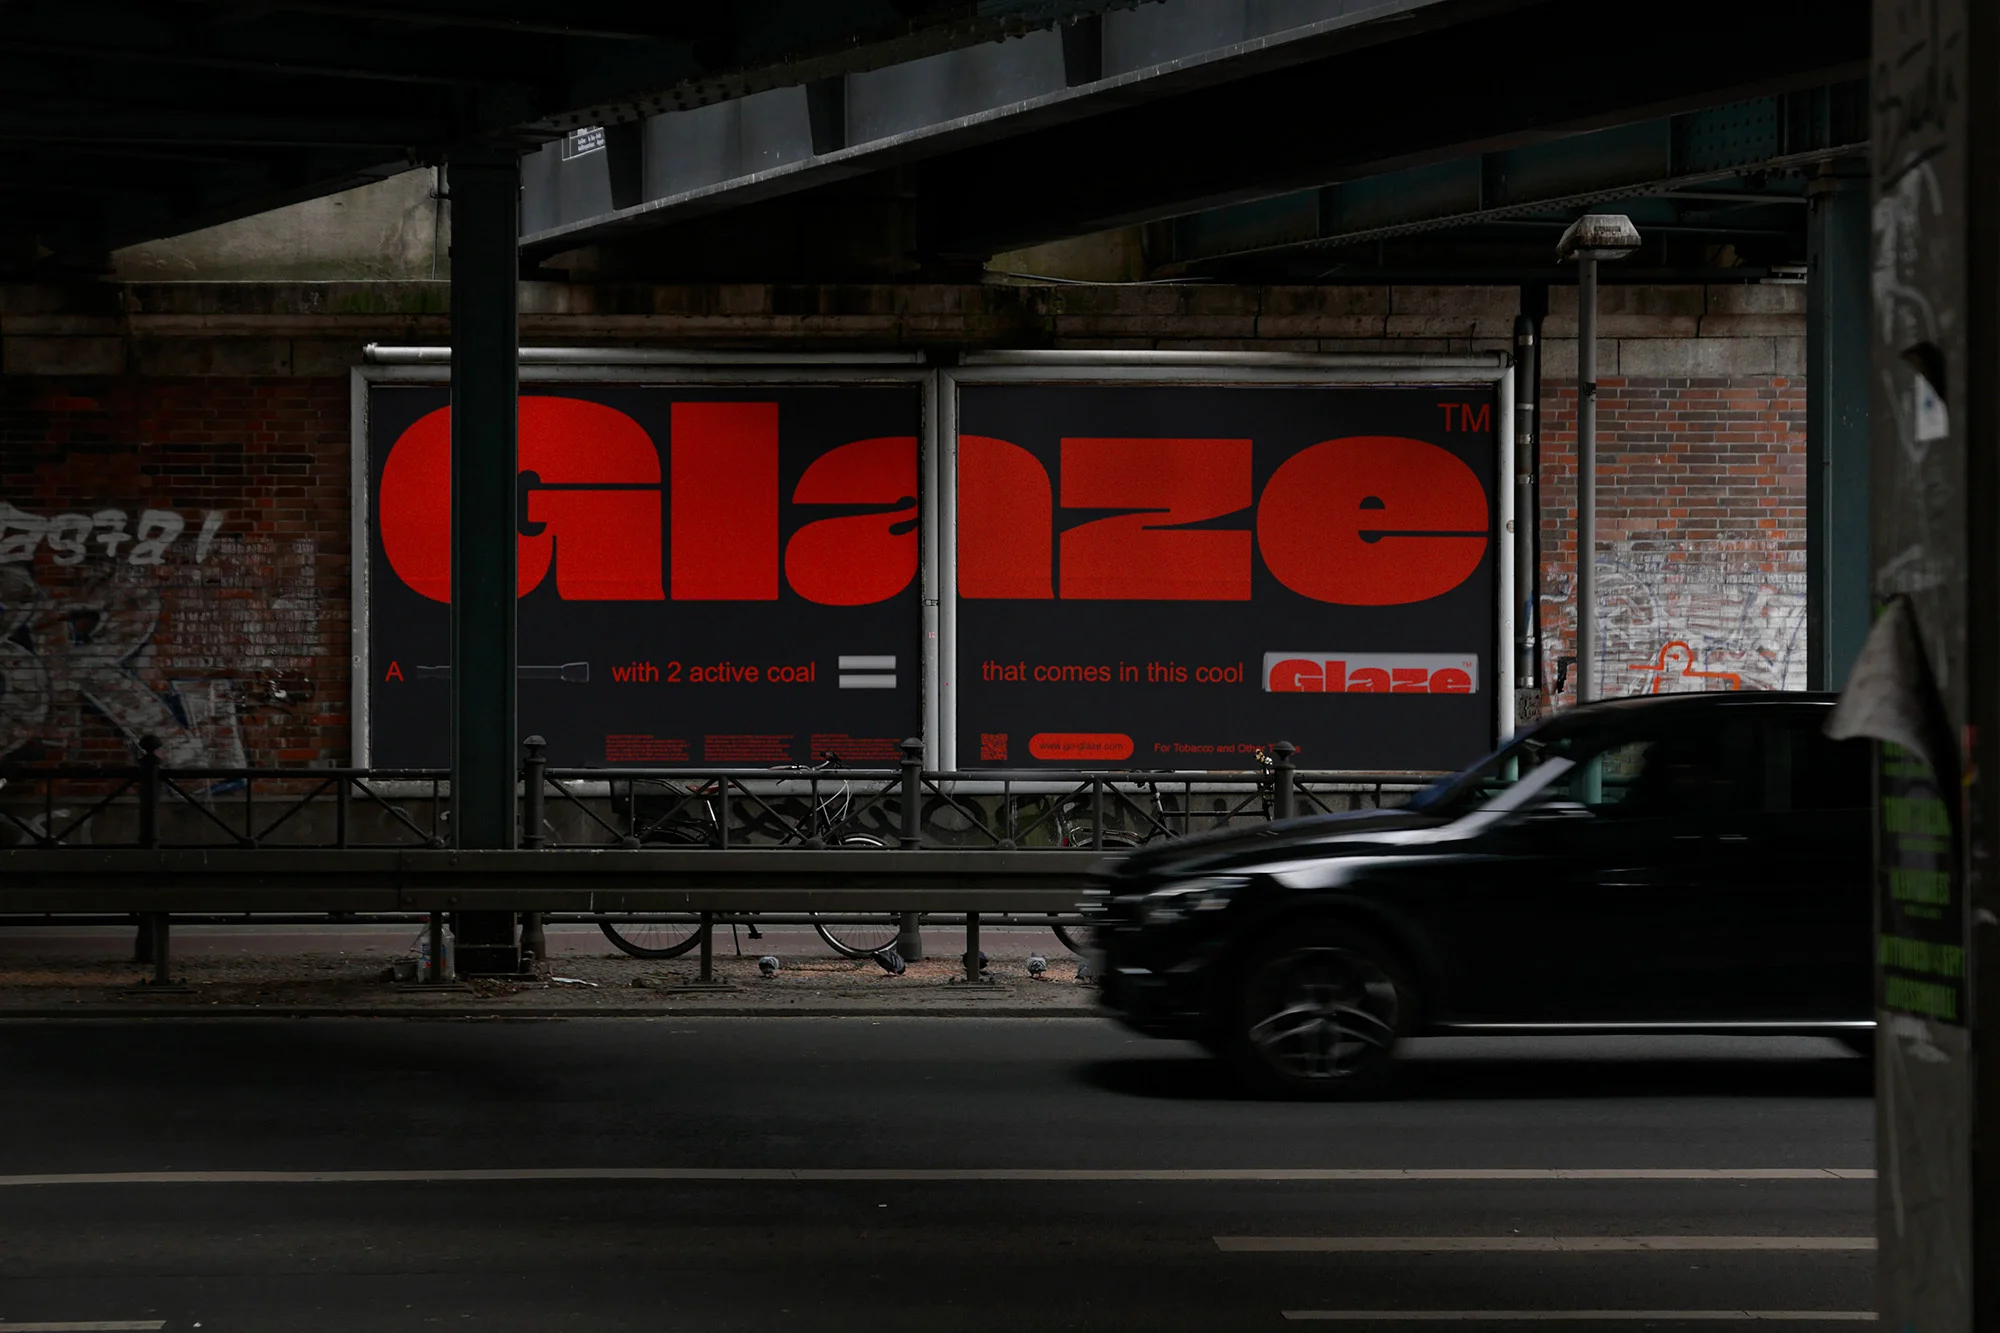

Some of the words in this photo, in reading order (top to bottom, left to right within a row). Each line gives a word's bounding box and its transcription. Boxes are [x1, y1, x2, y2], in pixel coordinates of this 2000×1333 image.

[380, 395, 1489, 607] Glaze
[385, 660, 405, 682] A
[611, 661, 660, 683] with
[667, 661, 682, 682] 2
[690, 661, 760, 683] active
[767, 661, 816, 683] coal
[981, 660, 1027, 683] that
[1034, 665, 1112, 683] comes
[1119, 661, 1139, 682] in
[1147, 661, 1189, 683] this
[1195, 661, 1244, 683] cool
[1269, 658, 1472, 694] Glaze
[1153, 743, 1171, 753] For
[1173, 742, 1215, 753] Tobacco
[1217, 743, 1235, 753] and
